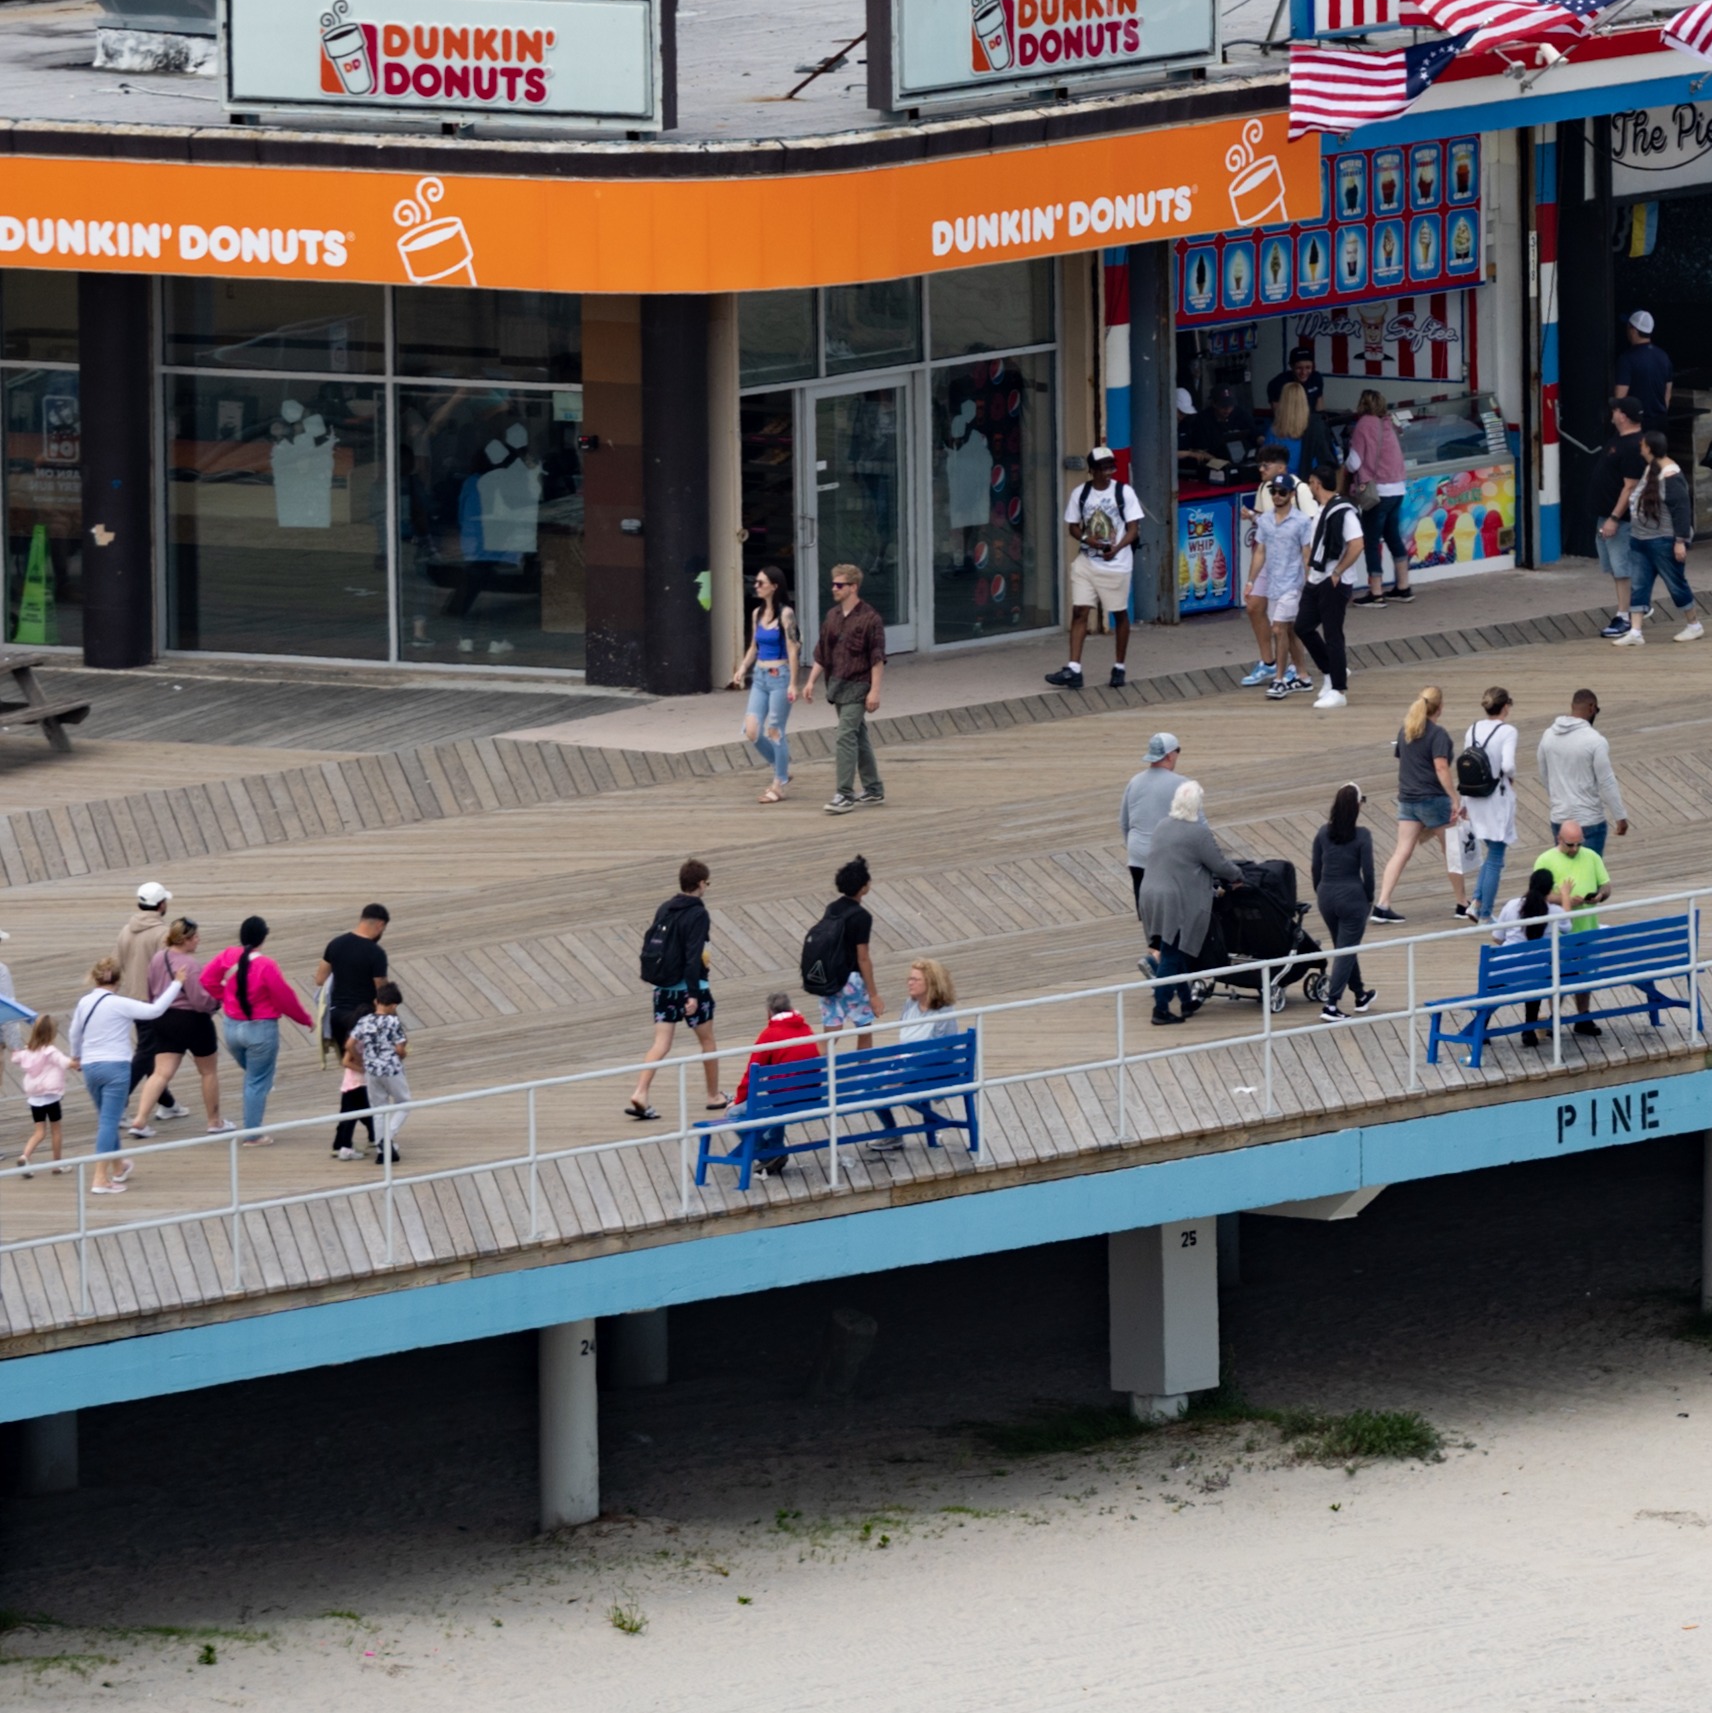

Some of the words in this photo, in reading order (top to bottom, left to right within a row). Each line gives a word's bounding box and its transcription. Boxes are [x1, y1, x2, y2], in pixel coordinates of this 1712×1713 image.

[383, 24, 555, 63] DUNKIN'
[1018, 18, 1140, 66] DONUTS
[384, 62, 547, 102] DONUTS
[1612, 107, 1667, 158] The
[0, 216, 172, 259] DUNKIN'
[179, 224, 348, 267] DONUTS
[932, 203, 1063, 256] DUNKIN'
[1068, 185, 1192, 236] DONUTS
[1293, 310, 1361, 339] Mister
[1384, 311, 1460, 354] Softee
[1188, 539, 1215, 553] WHIP
[1557, 1090, 1660, 1144] PINE
[1181, 1230, 1197, 1248] 25
